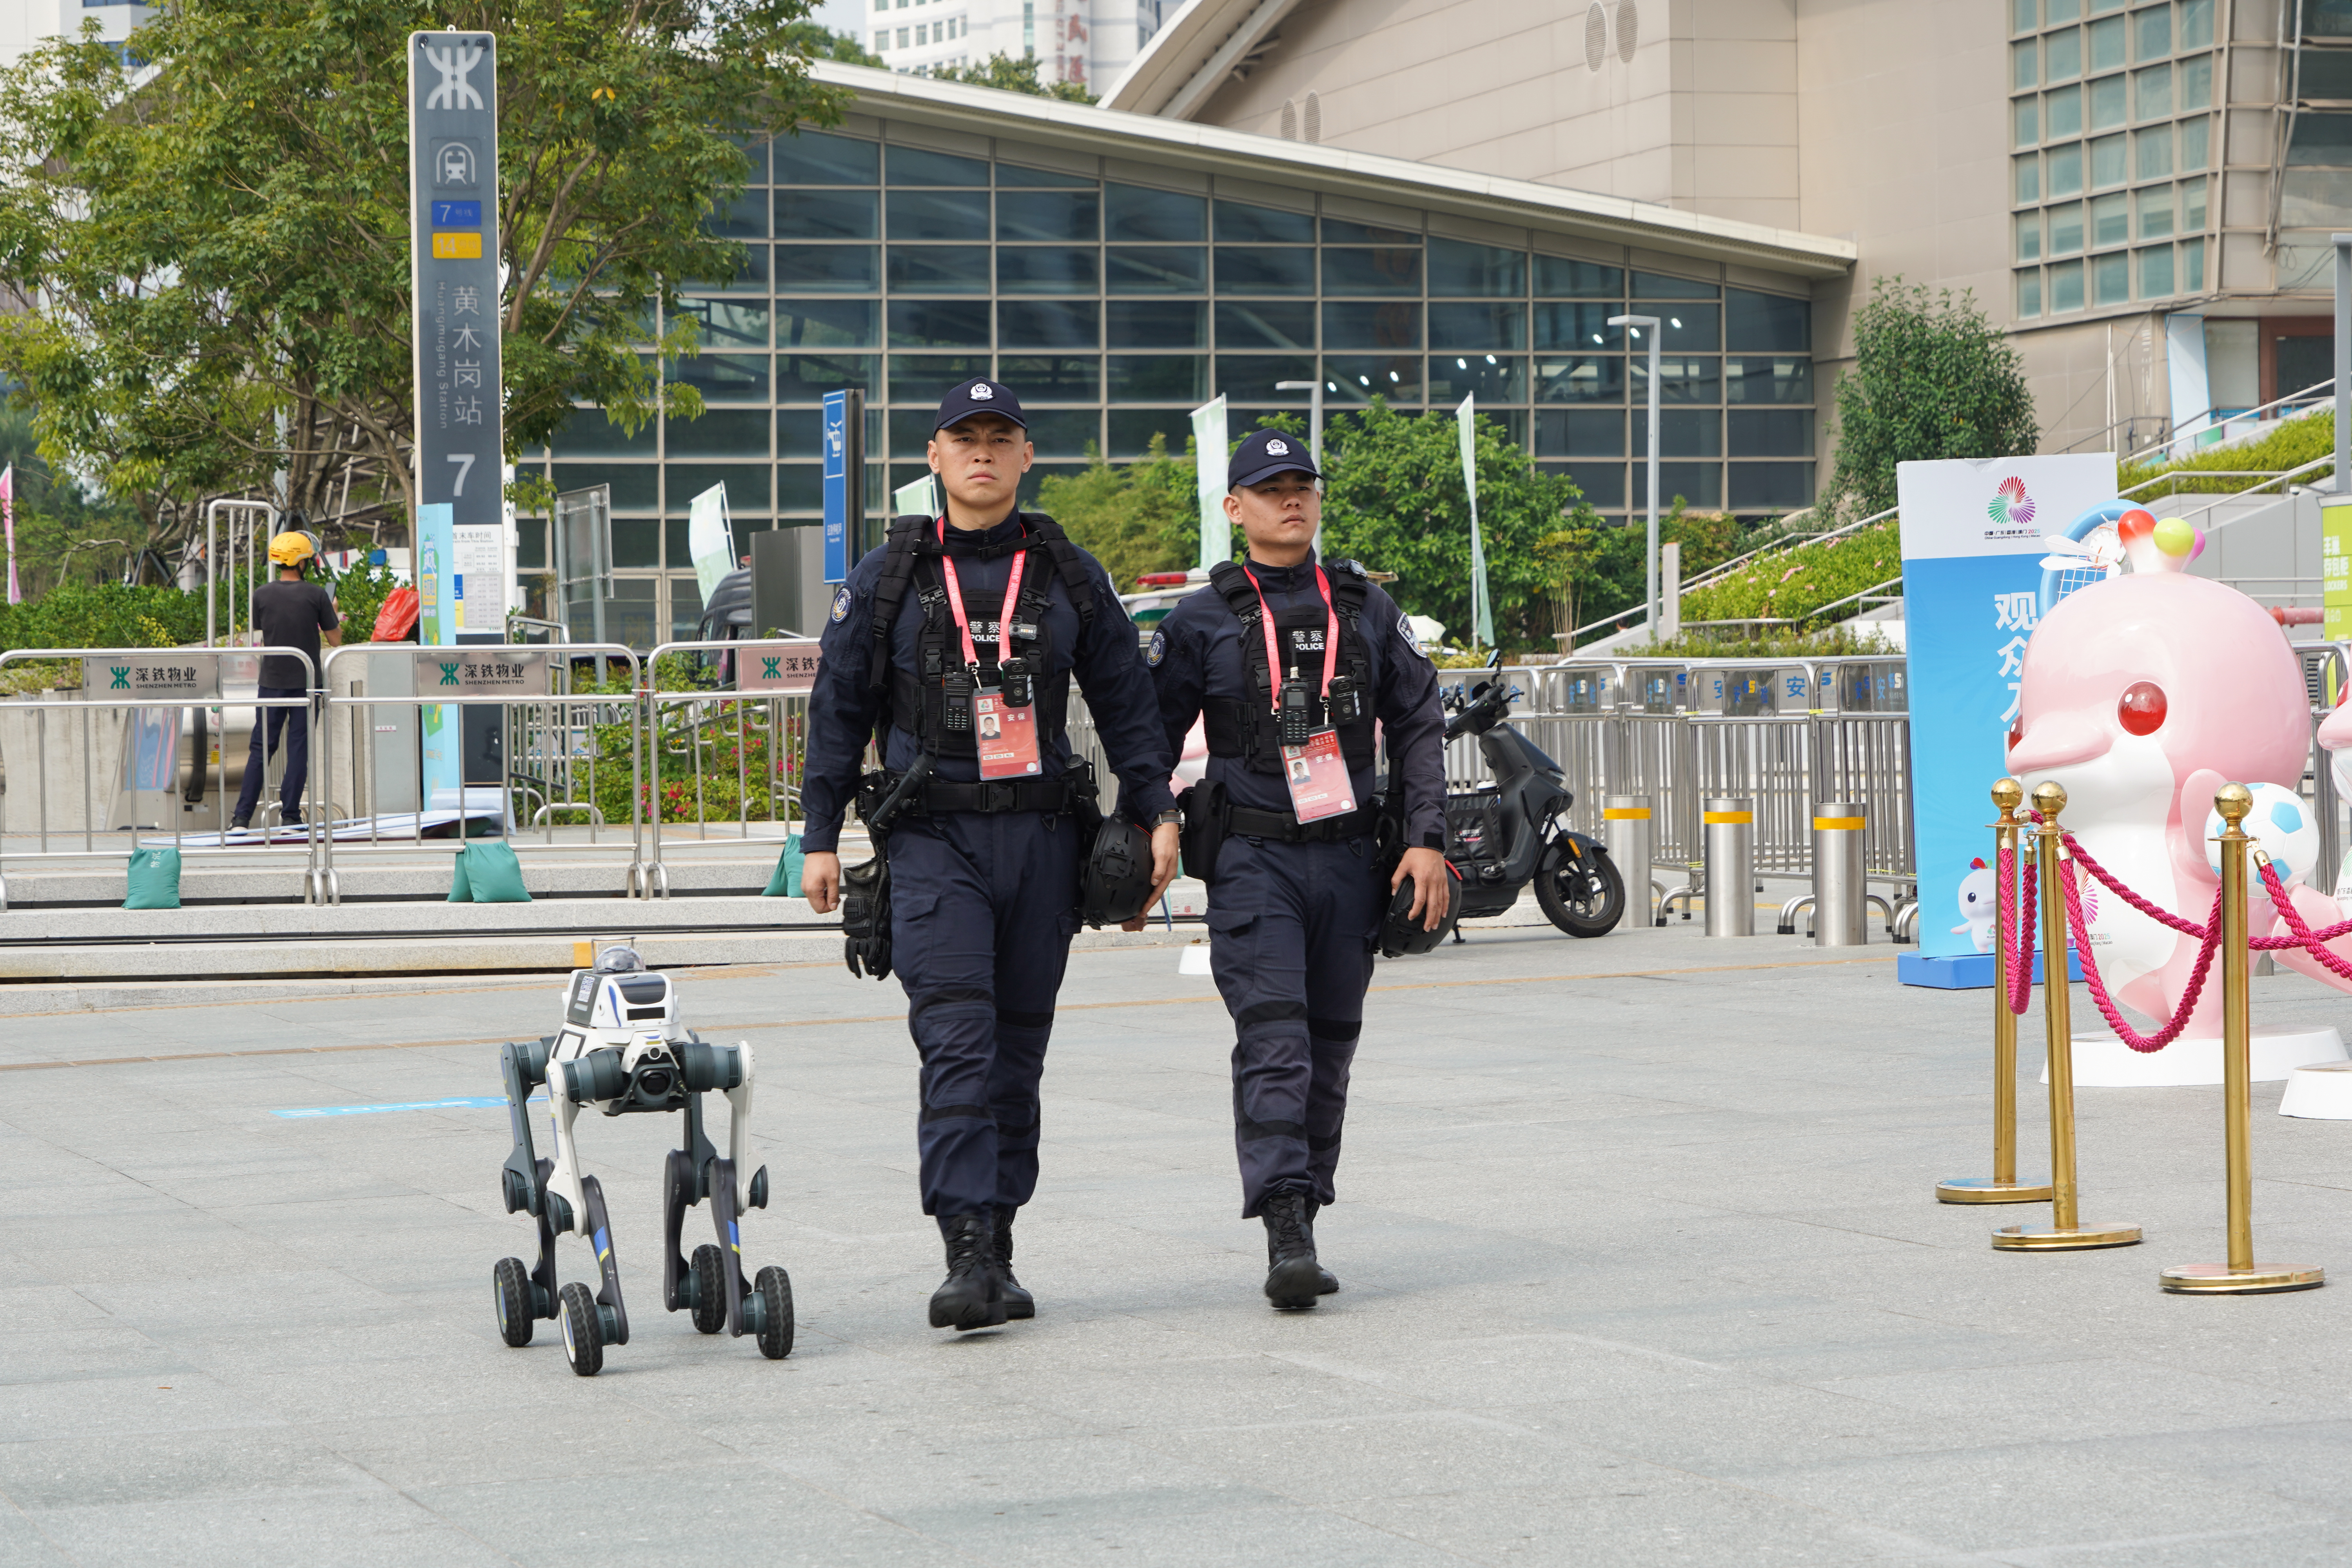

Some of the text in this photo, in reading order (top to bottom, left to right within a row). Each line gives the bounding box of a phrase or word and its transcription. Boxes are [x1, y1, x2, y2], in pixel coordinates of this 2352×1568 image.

[439, 204, 451, 223] 7
[437, 236, 457, 254] 14
[436, 281, 449, 429] Huangmugang Station
[451, 285, 483, 426] 黄木岗站
[446, 453, 476, 497] 7
[969, 621, 1000, 633] 警察
[1292, 630, 1323, 642] 警察
[1295, 642, 1325, 651] POLICE
[136, 667, 196, 682] 深铁物业
[465, 663, 524, 678] 深铁物业
[1786, 676, 1806, 697] 安
[1877, 676, 1886, 700] 安
[1007, 713, 1026, 722] 安保
[1315, 753, 1334, 764] 安保
